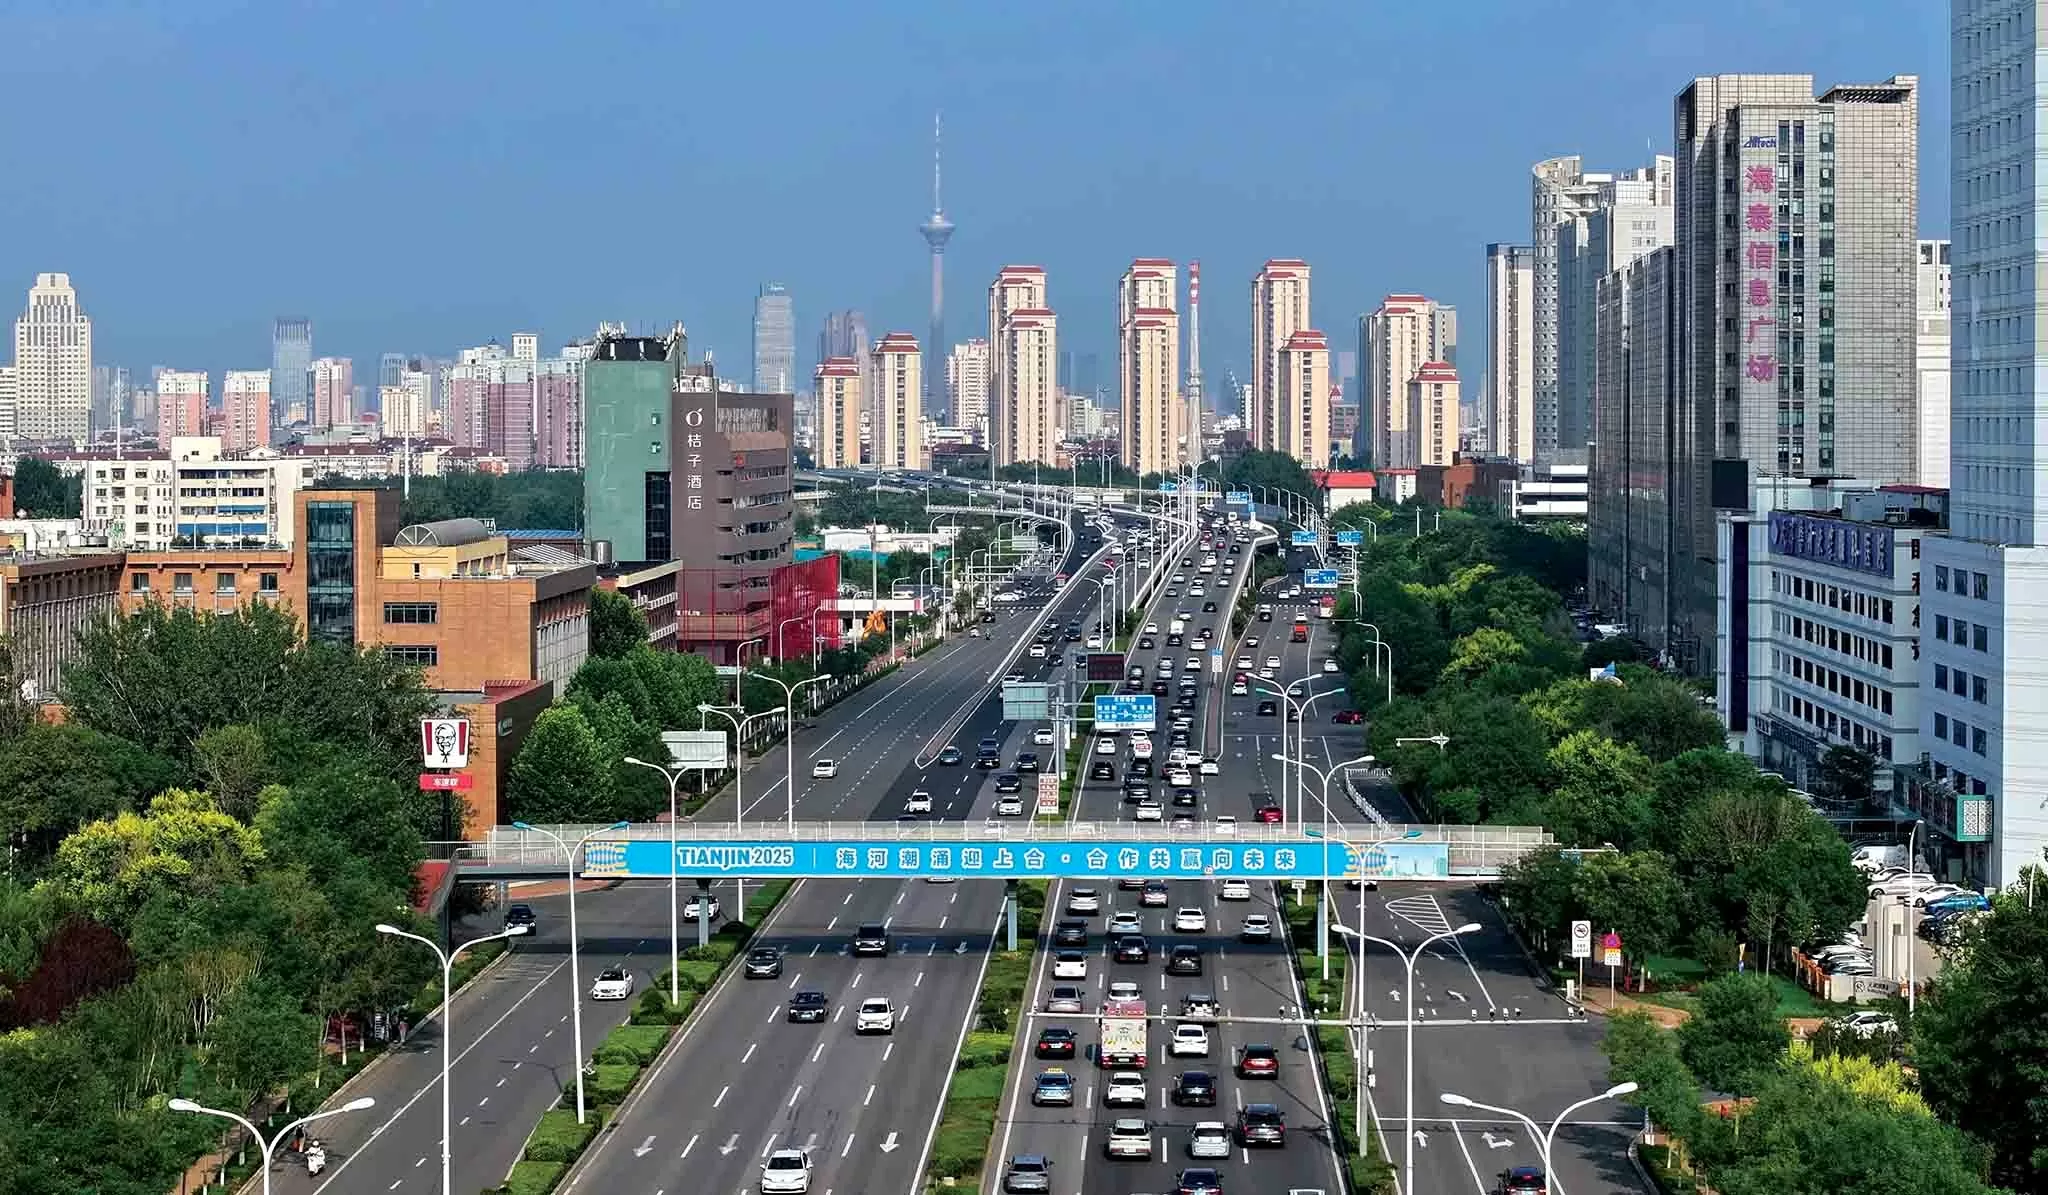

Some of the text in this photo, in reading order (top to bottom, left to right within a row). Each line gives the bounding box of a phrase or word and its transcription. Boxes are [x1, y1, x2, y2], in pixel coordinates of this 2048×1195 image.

[1745, 166, 1775, 383] 海泰信息广场
[687, 433, 702, 510] 桔子酒店
